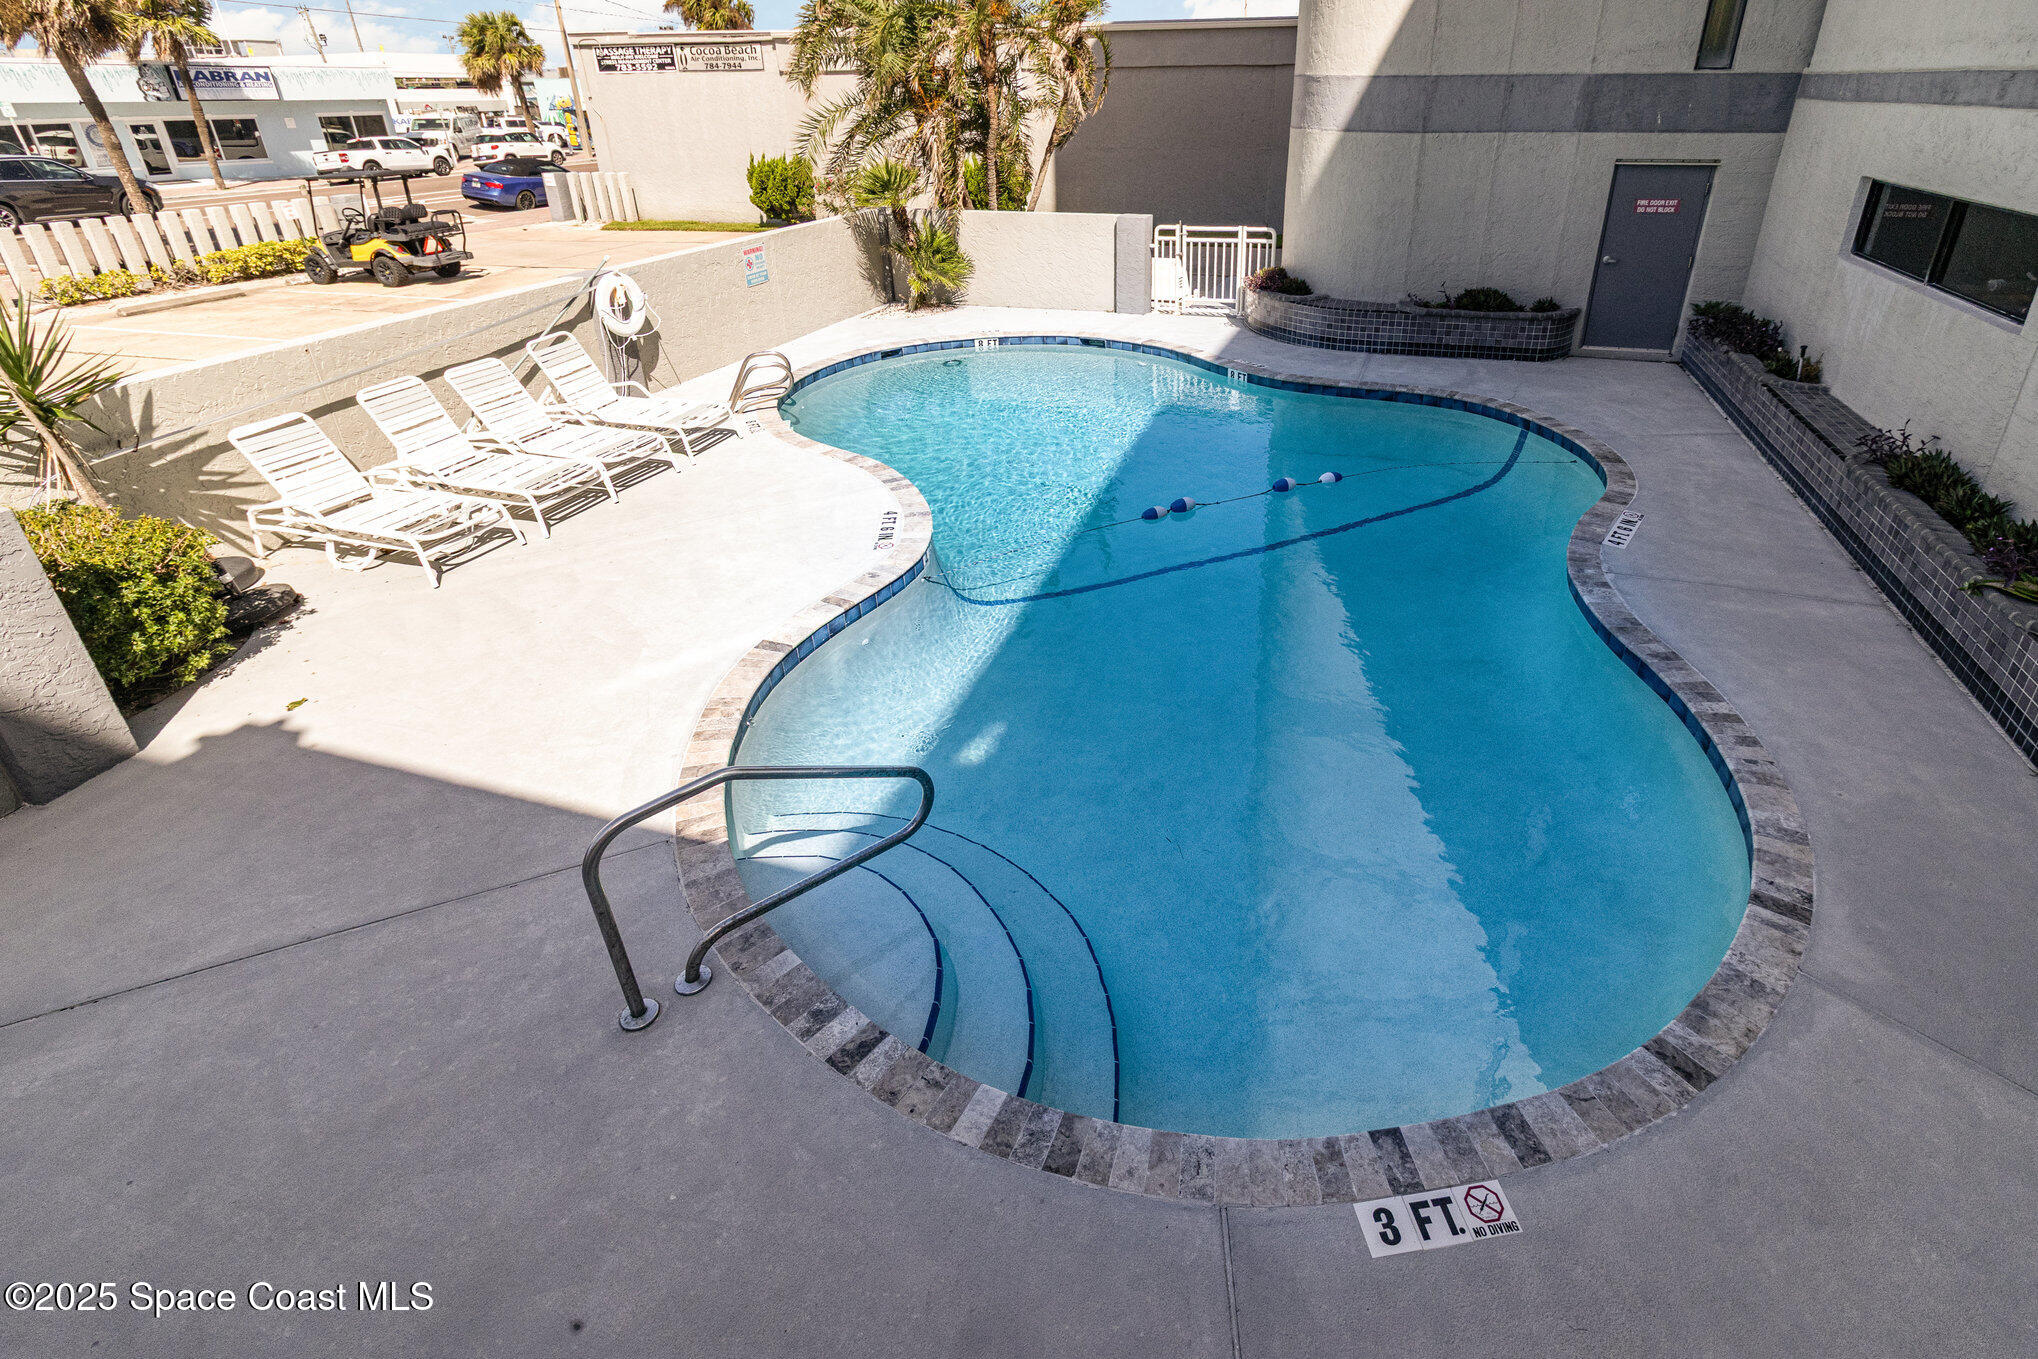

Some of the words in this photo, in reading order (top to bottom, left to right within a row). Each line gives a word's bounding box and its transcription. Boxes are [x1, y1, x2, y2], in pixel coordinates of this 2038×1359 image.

[634, 46, 671, 54] THERAPY
[690, 46, 721, 55] Cocoa
[724, 45, 757, 55] Beach
[1230, 370, 1235, 378] 8
[1237, 372, 1246, 381] FT
[1372, 1207, 1401, 1246] 3
[1409, 1196, 1466, 1241] FT.
[1473, 1226, 1487, 1238] NO
[1489, 1221, 1520, 1235] DIVING
